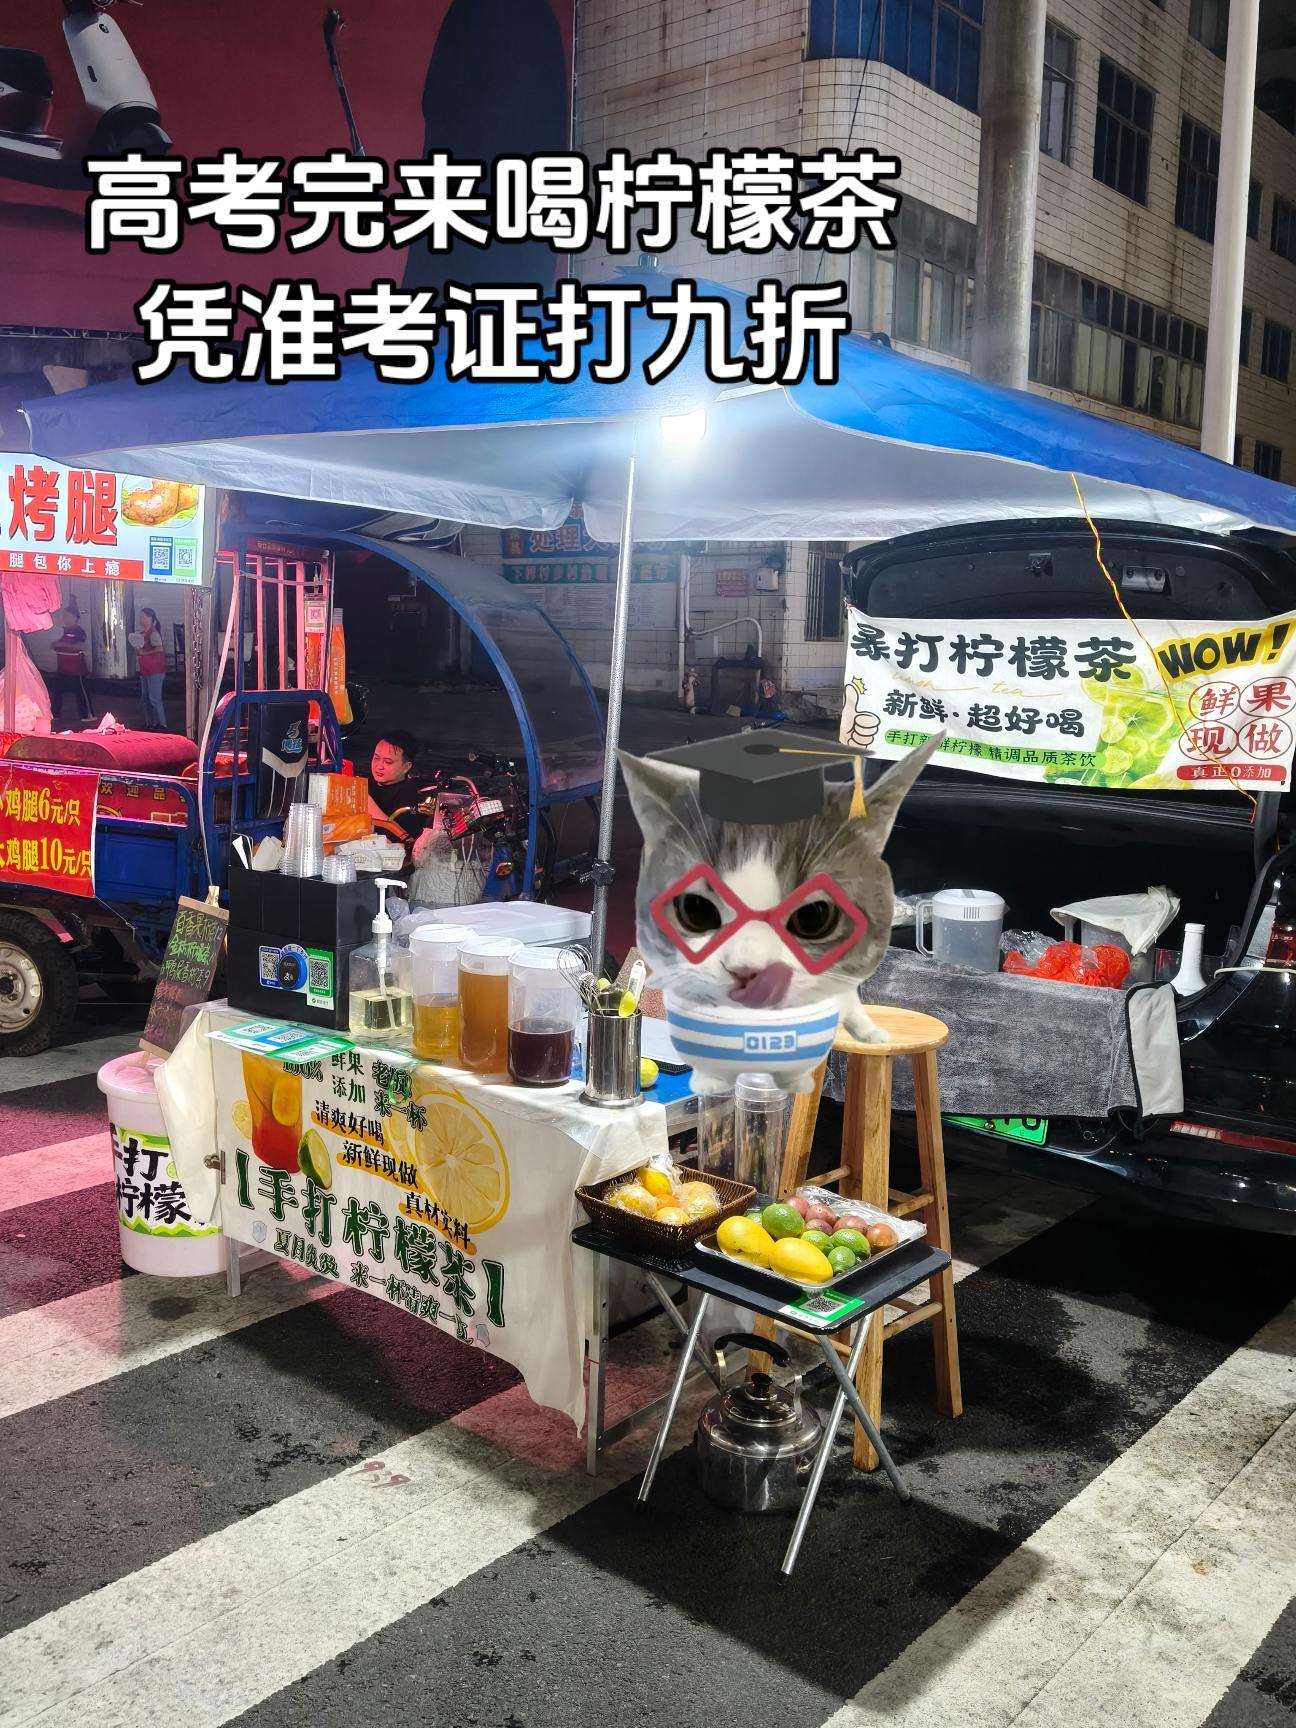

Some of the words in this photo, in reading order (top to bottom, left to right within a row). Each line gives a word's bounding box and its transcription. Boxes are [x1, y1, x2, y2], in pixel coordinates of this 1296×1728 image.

[1157, 623, 1291, 680] WOW!
[1199, 681, 1292, 717] 鲜果
[1186, 723, 1284, 755] 现做
[0, 787, 81, 827] 鸡腿6元/只
[100, 781, 186, 803] 欢迎品
[331, 1074, 366, 1104] 添加
[314, 1099, 385, 1147] 清爽好喝
[342, 1139, 420, 1190] 新鲜现做
[405, 1191, 471, 1251] 真材实料
